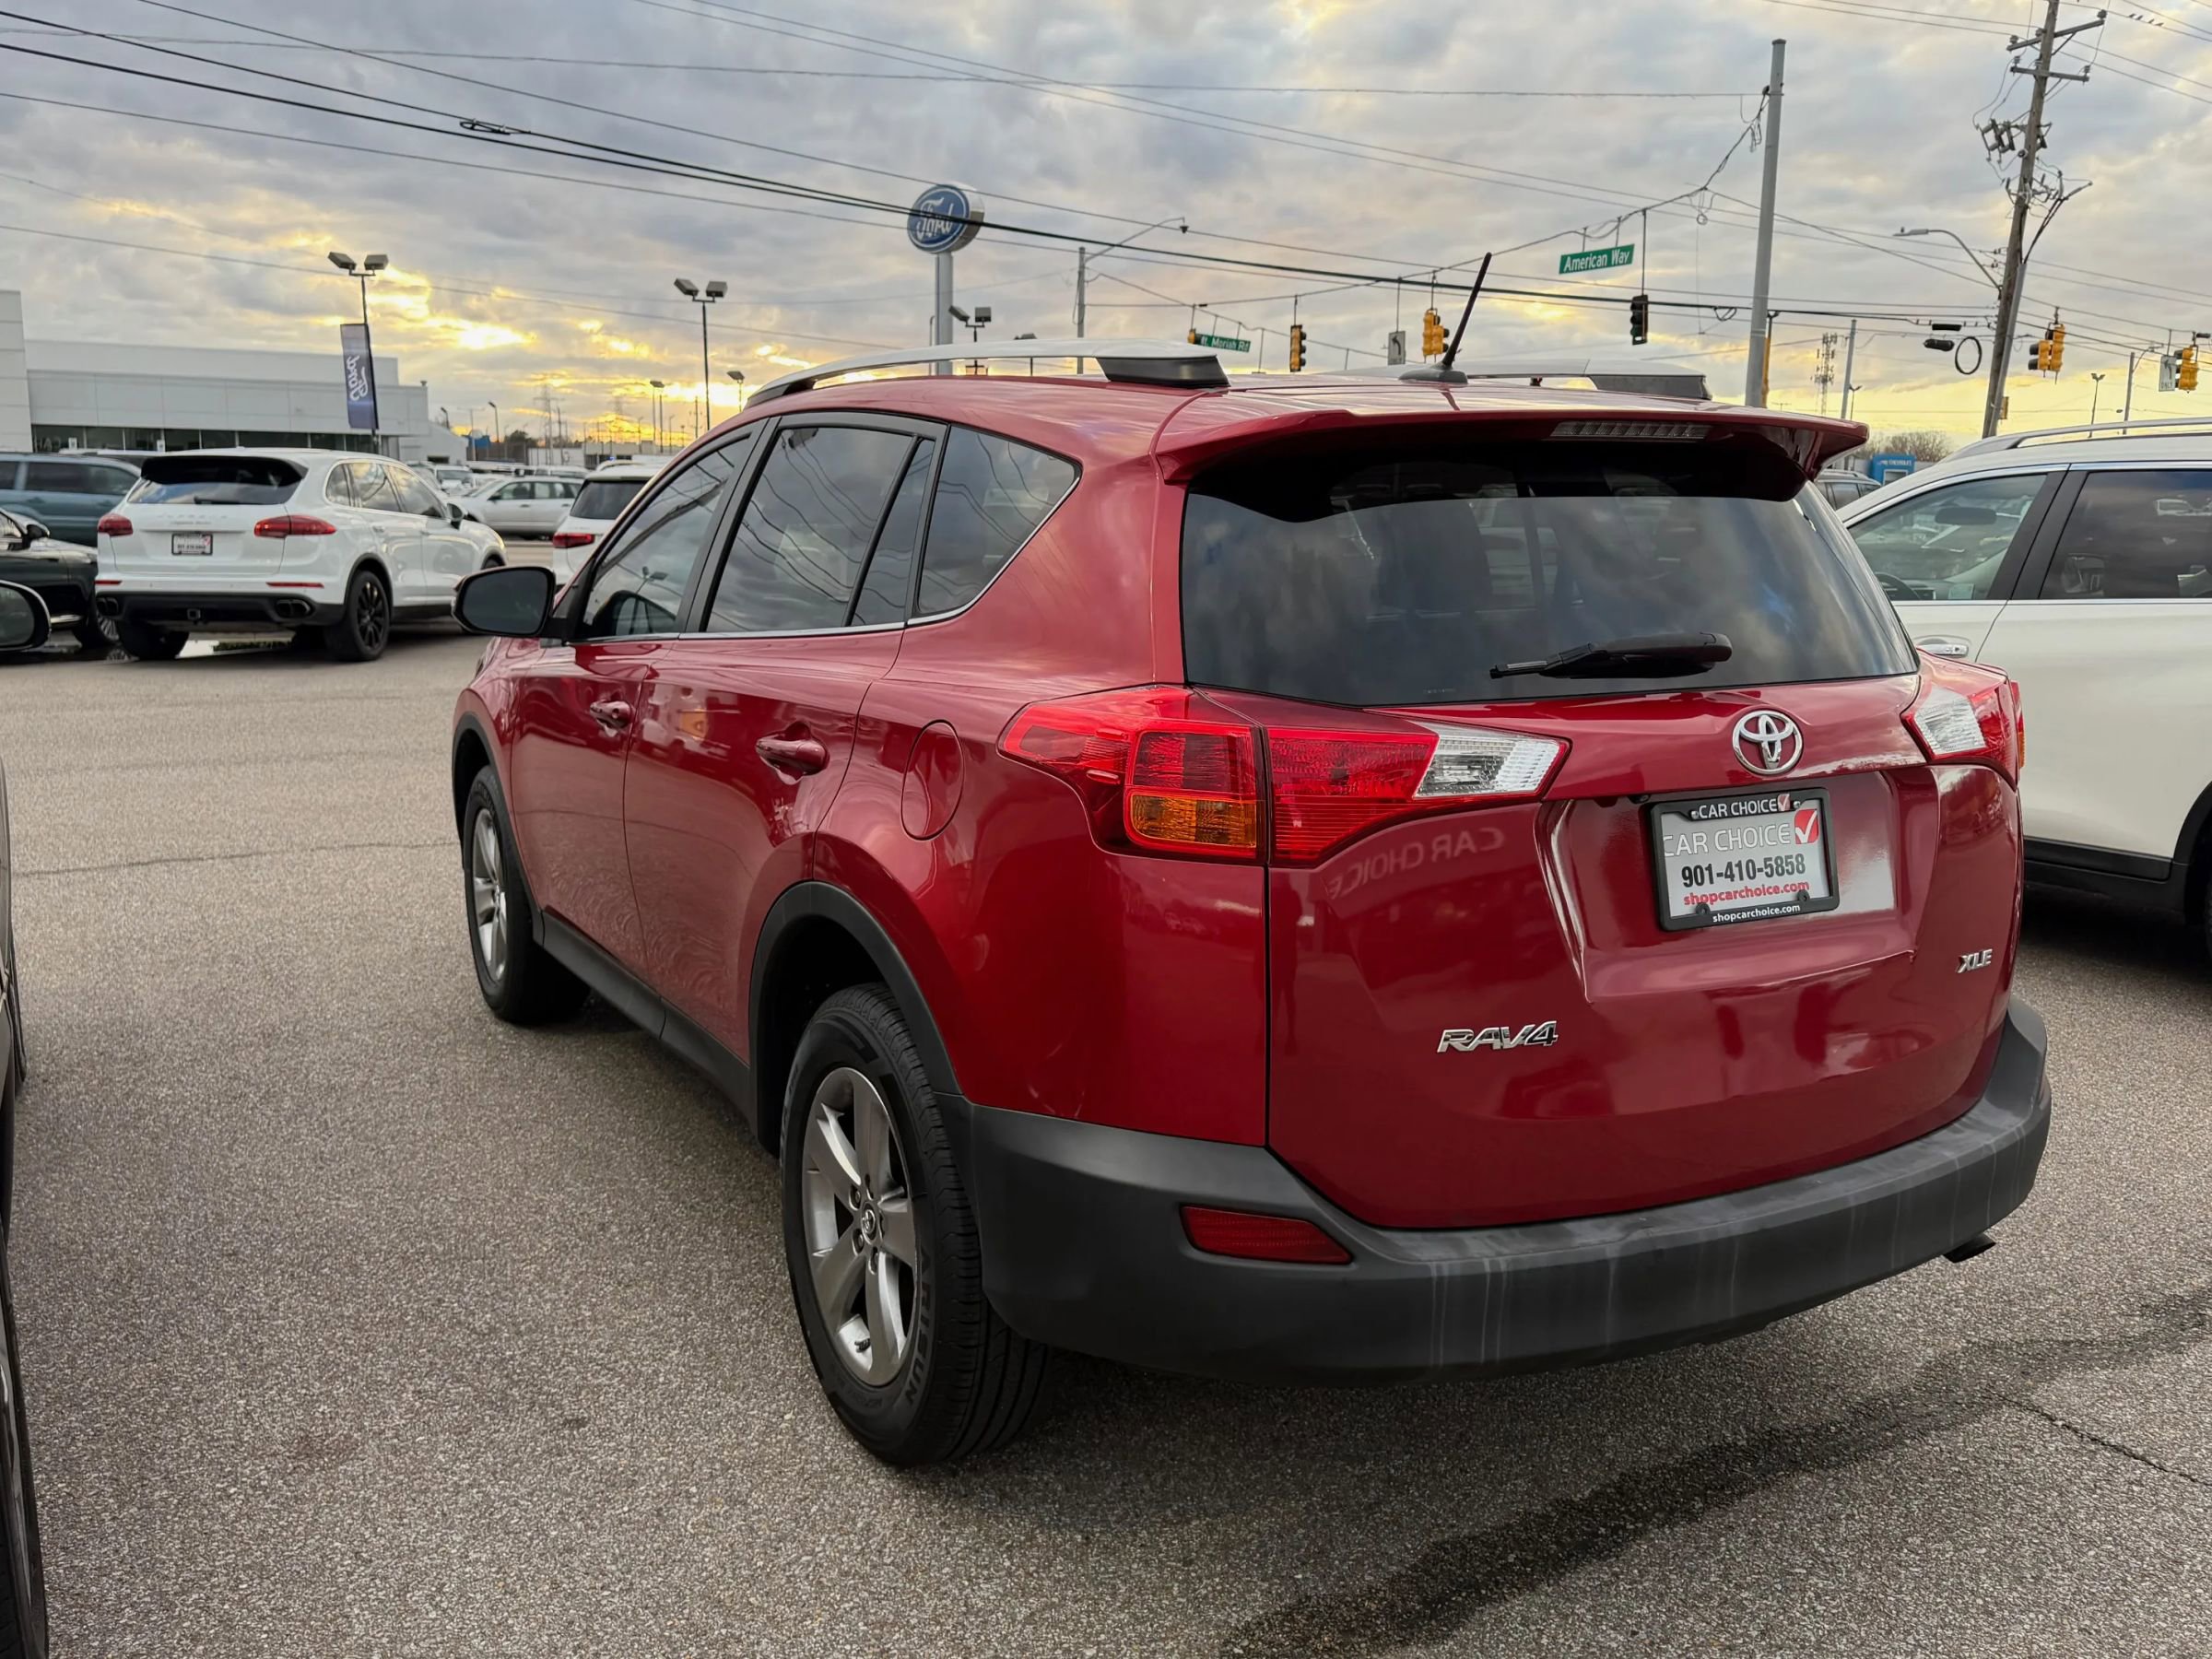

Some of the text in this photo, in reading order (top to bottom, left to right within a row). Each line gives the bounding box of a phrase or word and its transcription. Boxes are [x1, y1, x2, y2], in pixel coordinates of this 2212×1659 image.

[916, 196, 954, 240] Ford
[1563, 249, 1630, 273] American Way
[1238, 341, 1249, 350] Rd
[1699, 797, 1778, 818] CAR CHOICE
[1714, 823, 1790, 853] CHOICE
[1681, 853, 1806, 888] 901-410-5858
[1684, 880, 1809, 905] shopcarchoice.com
[1712, 904, 1800, 923] shopcarchoice.com
[1956, 948, 1993, 973] XLE
[1437, 1020, 1558, 1053] RAV4
